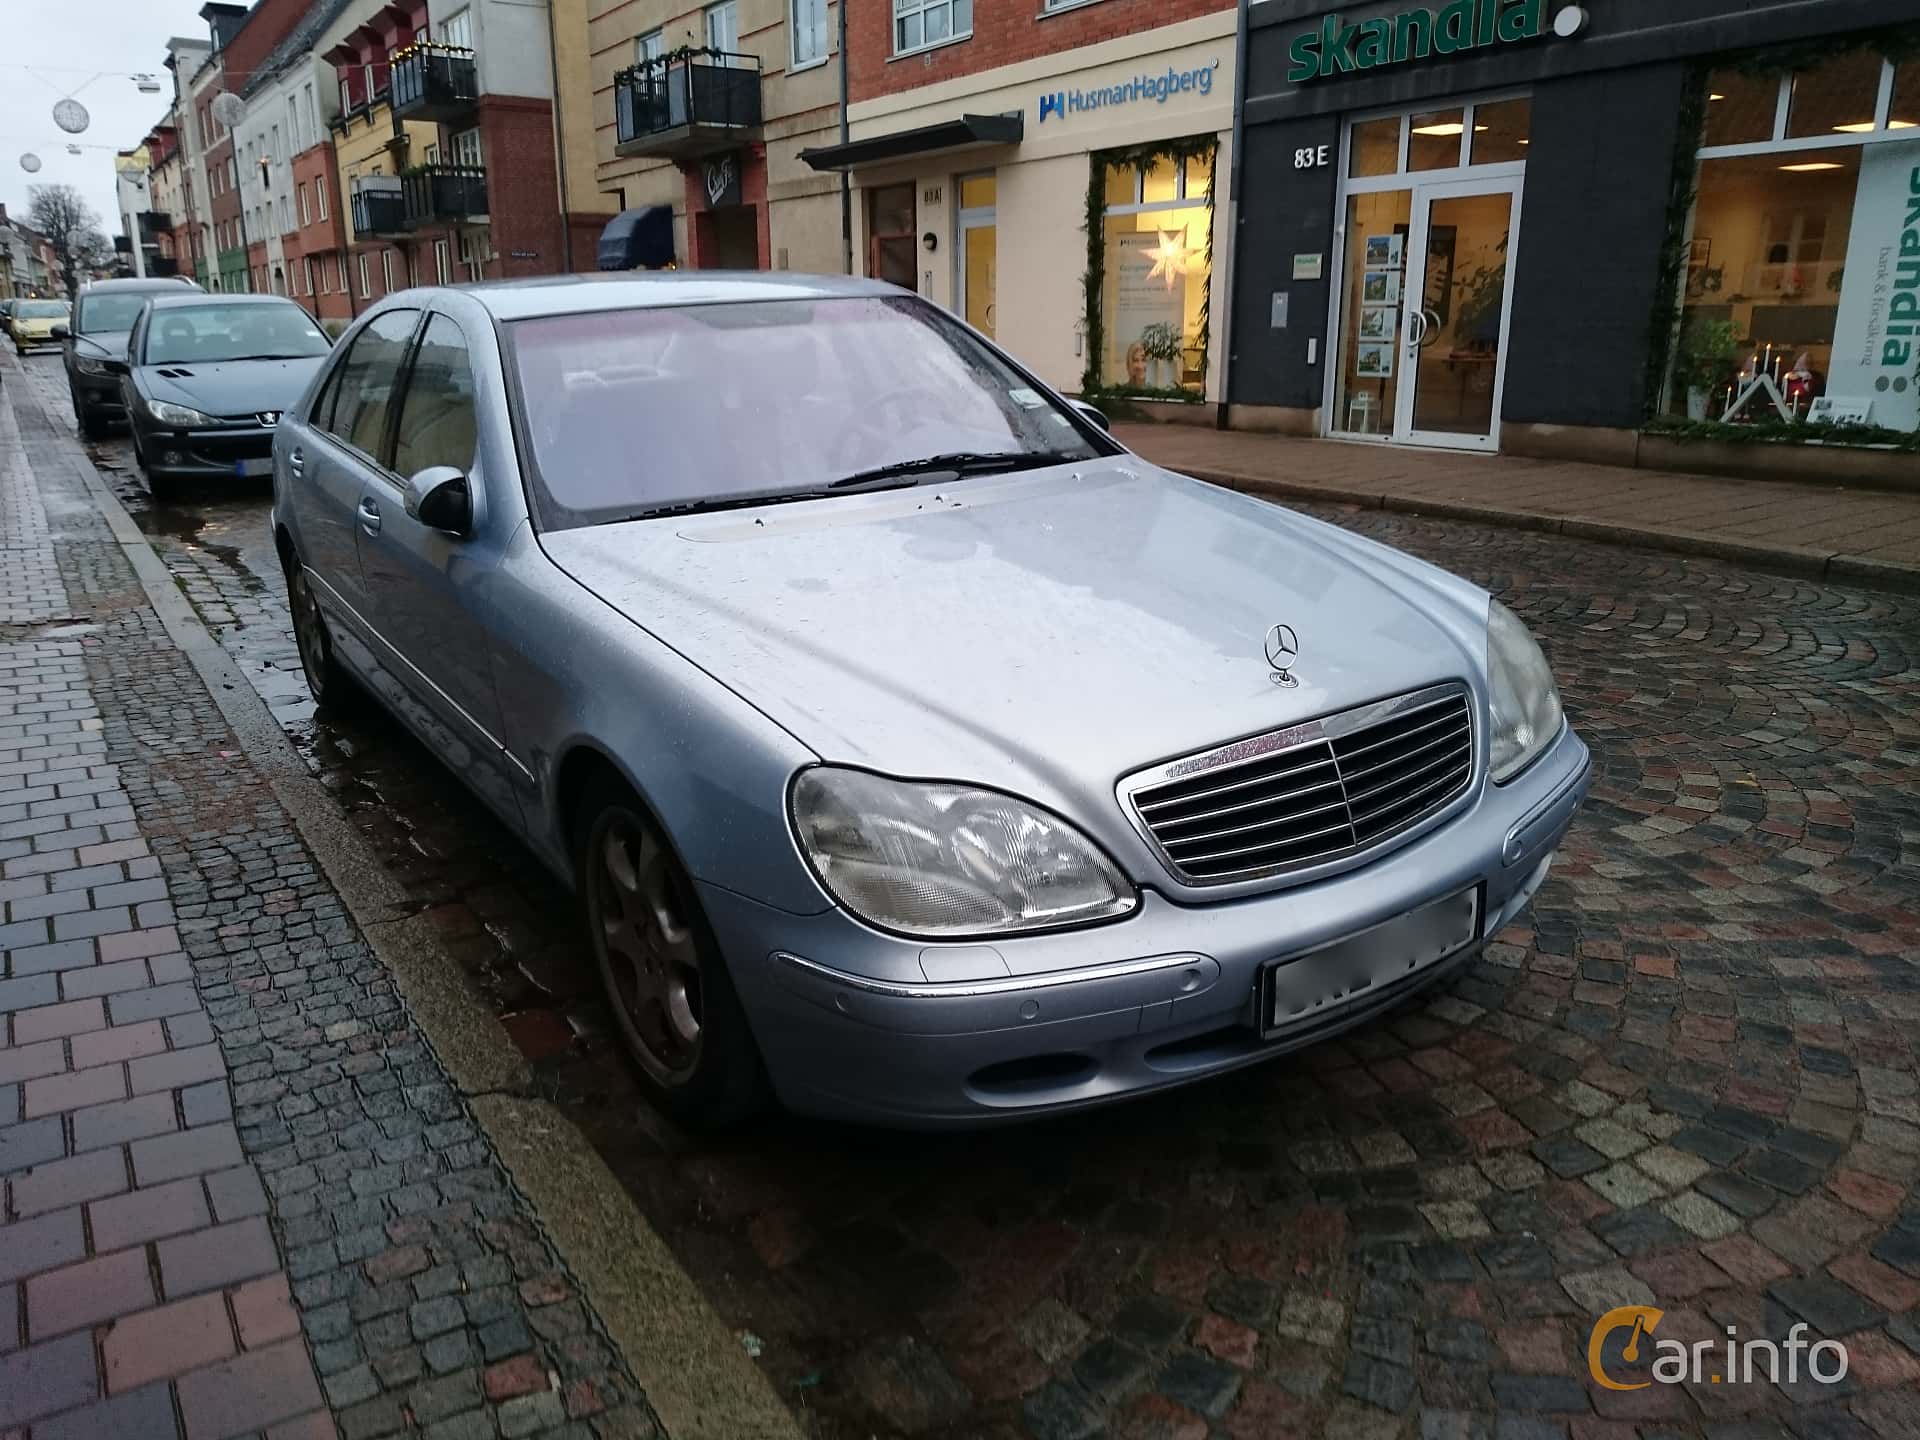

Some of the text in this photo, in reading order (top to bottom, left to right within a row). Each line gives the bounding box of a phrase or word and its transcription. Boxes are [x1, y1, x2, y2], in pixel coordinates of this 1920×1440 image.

[1294, 144, 1329, 169] 83 E
[1878, 246, 1893, 280] bank
[1873, 284, 1887, 294] &
